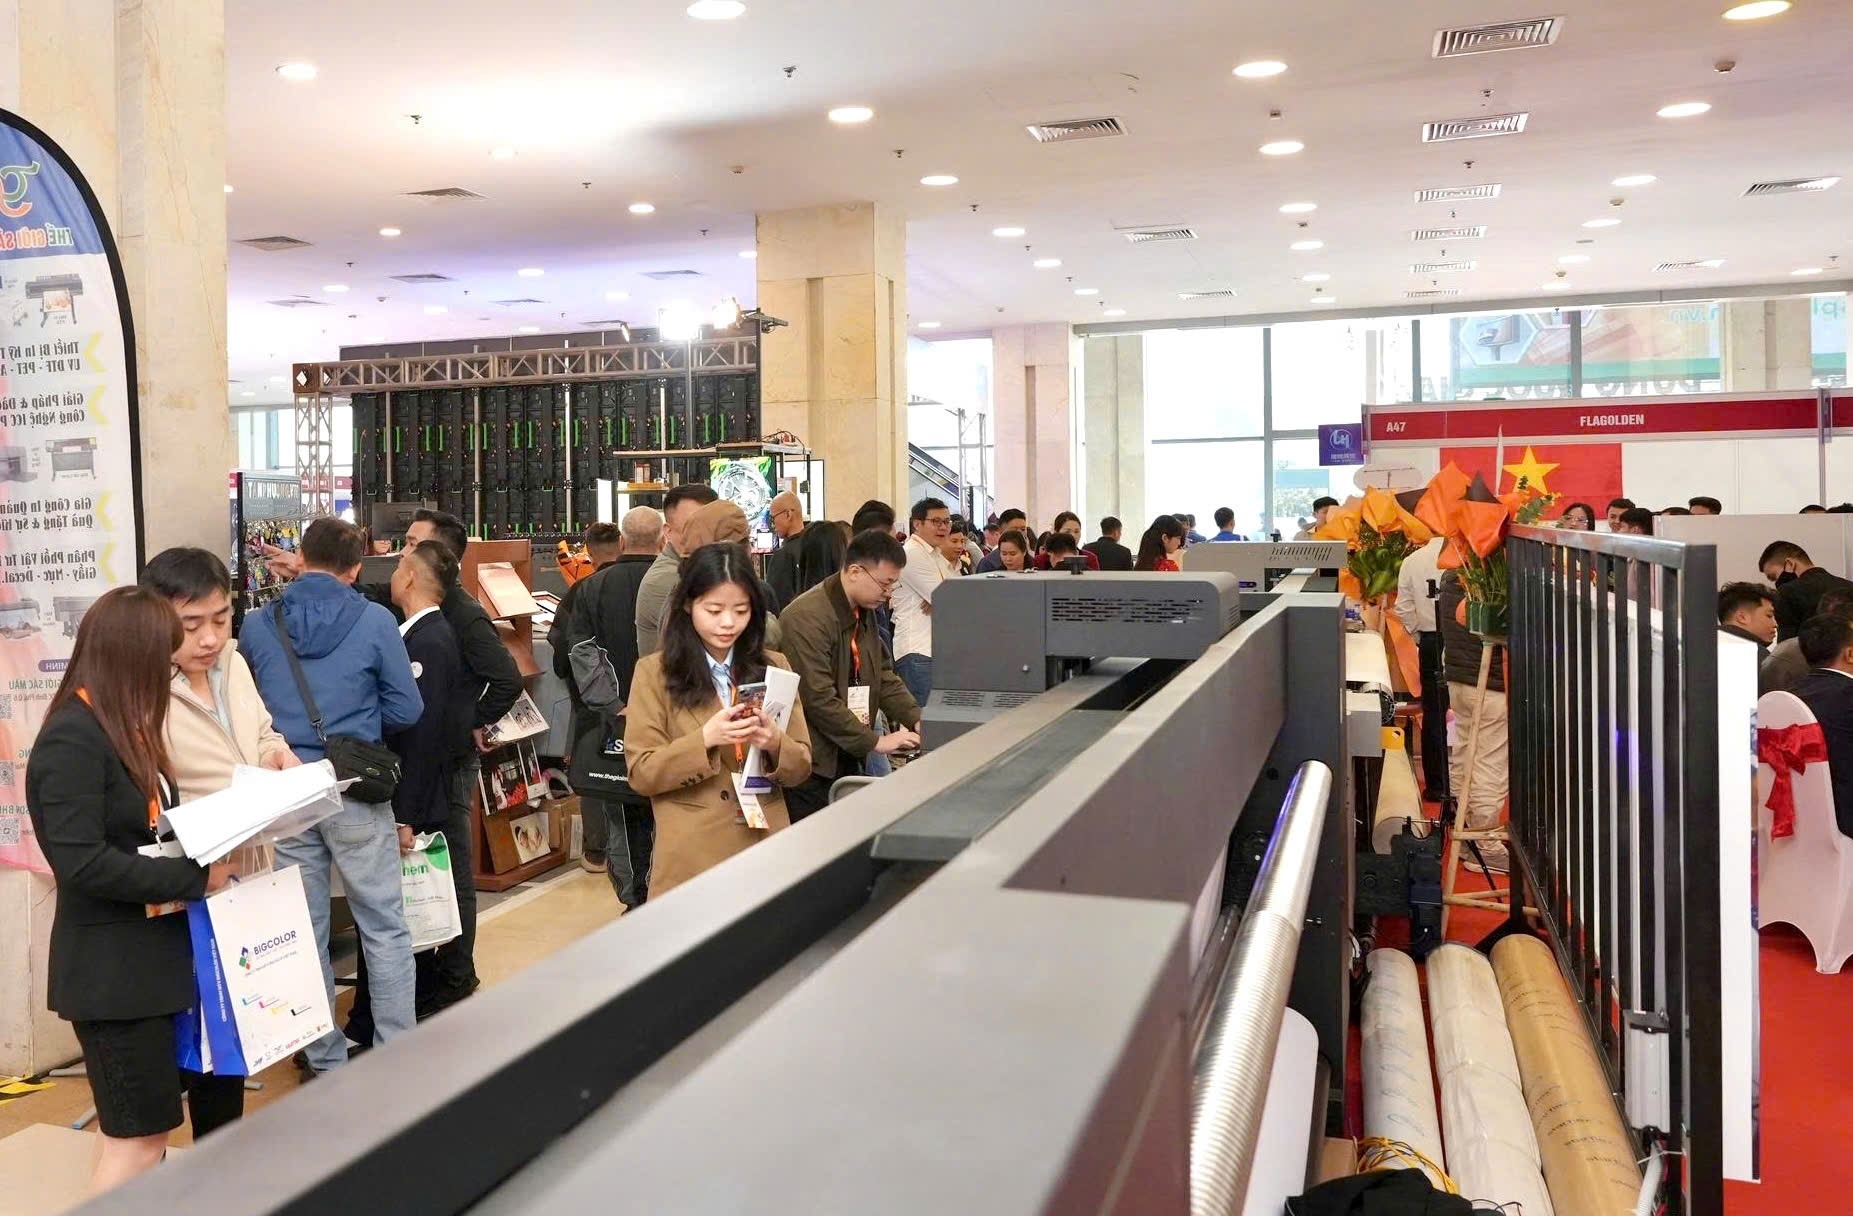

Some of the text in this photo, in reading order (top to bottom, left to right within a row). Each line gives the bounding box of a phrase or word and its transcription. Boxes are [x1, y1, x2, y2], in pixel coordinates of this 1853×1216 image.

[1386, 421, 1406, 432] A47
[1580, 414, 1644, 427] FLAGOLDEN
[253, 930, 297, 955] BIGCOLOR
